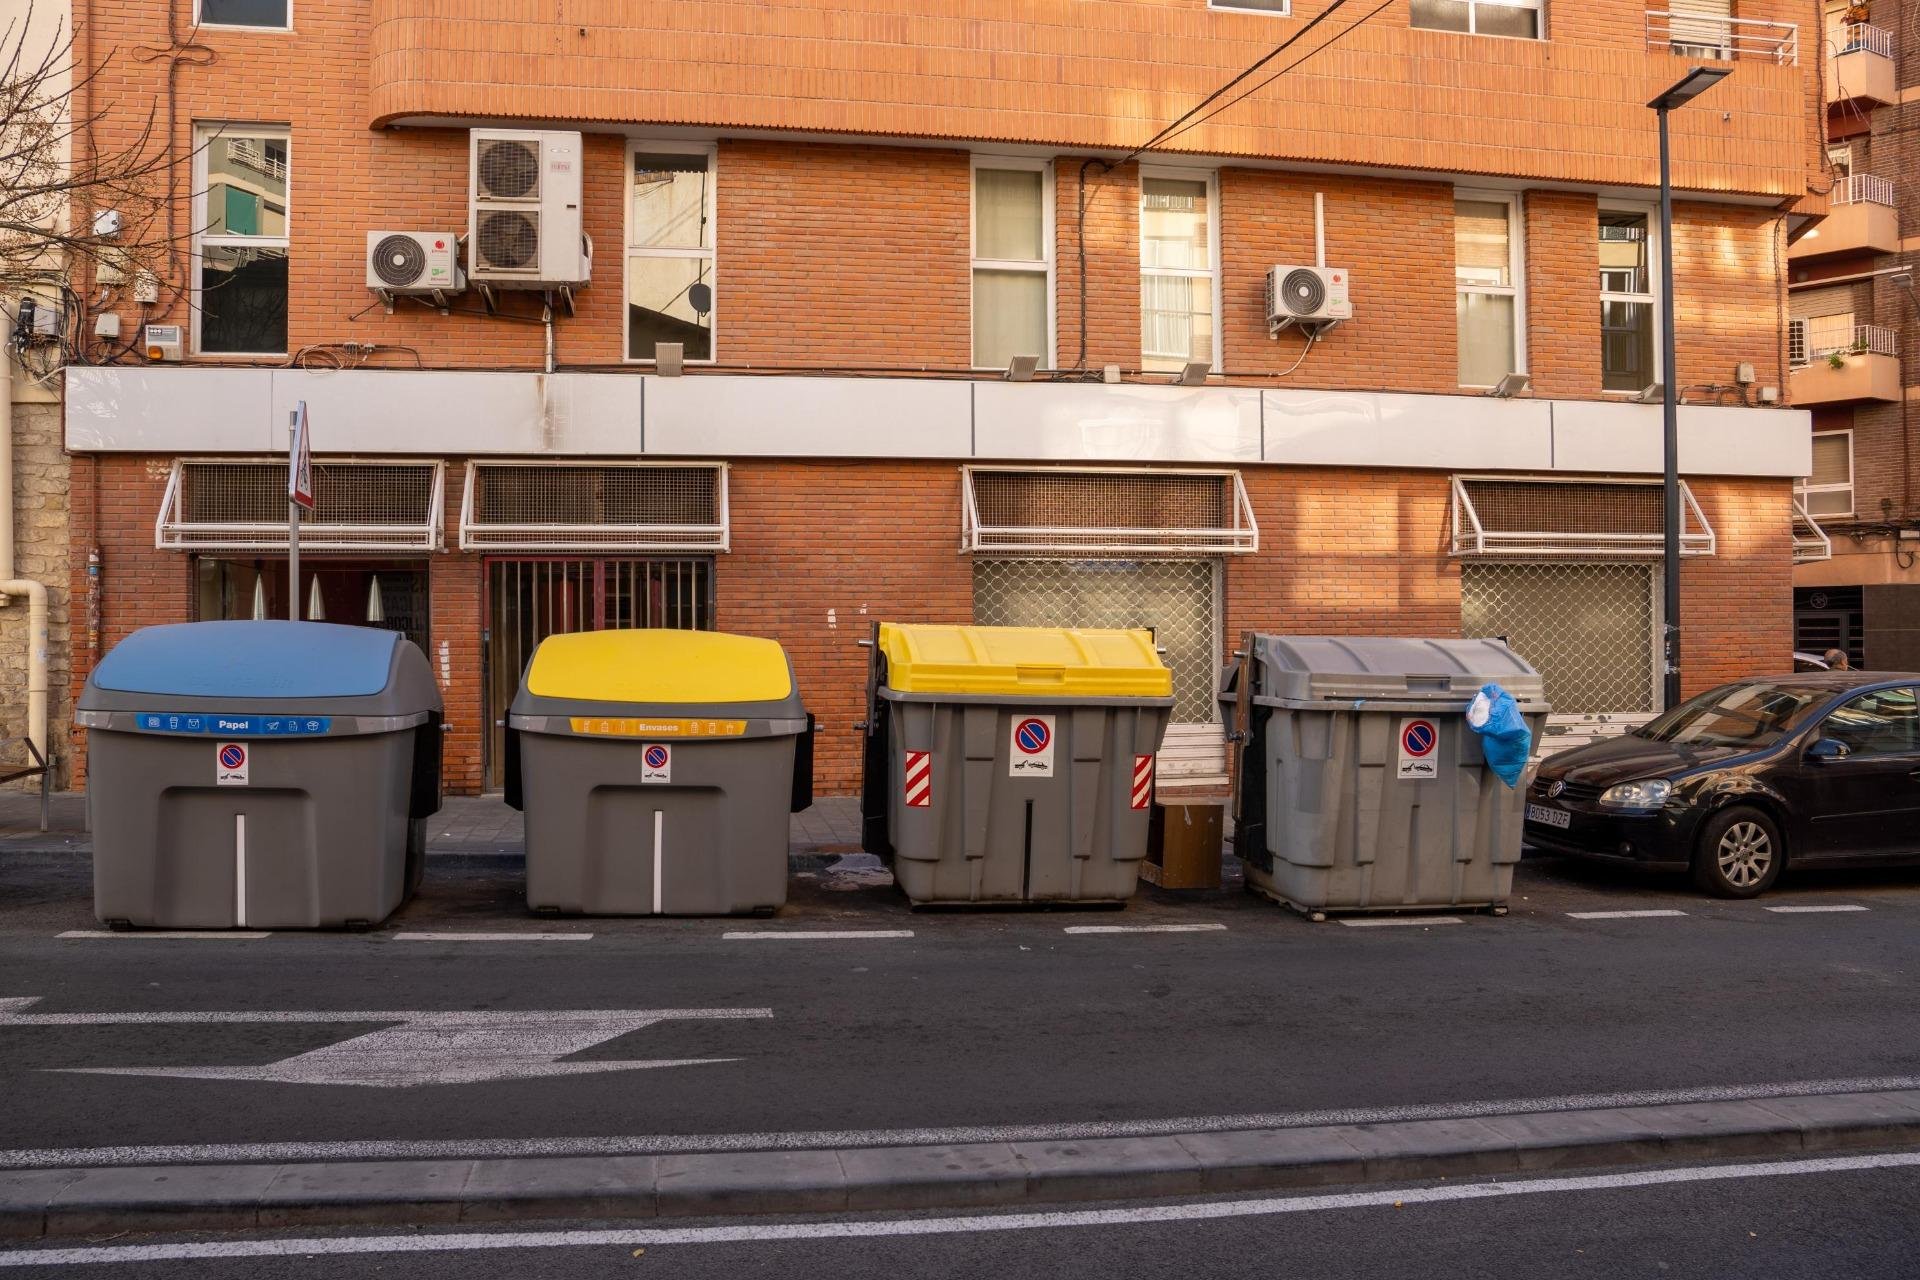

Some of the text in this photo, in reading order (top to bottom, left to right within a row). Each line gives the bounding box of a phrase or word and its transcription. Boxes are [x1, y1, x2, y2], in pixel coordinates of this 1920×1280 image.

[218, 720, 249, 730] Papel
[639, 723, 679, 732] Envases
[1531, 806, 1550, 822] 8053
[1552, 811, 1568, 824] DZF
